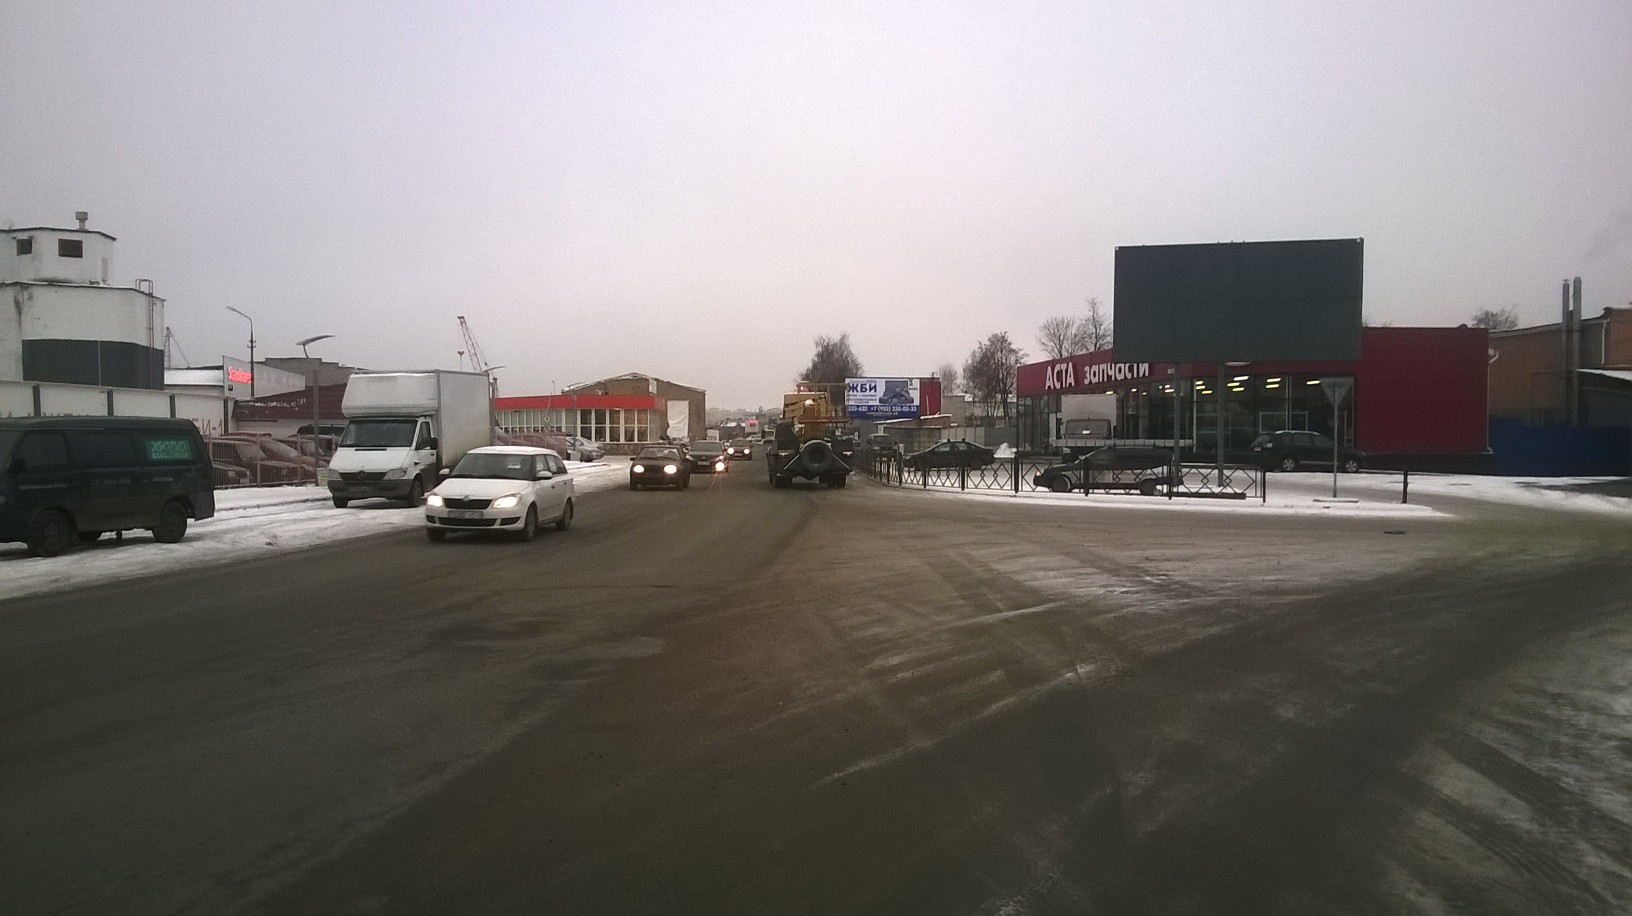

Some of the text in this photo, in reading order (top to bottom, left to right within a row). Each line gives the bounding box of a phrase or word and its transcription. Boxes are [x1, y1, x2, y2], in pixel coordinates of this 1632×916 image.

[1045, 362, 1149, 390] АСТА запчасти
[848, 383, 877, 393] ЖБИ
